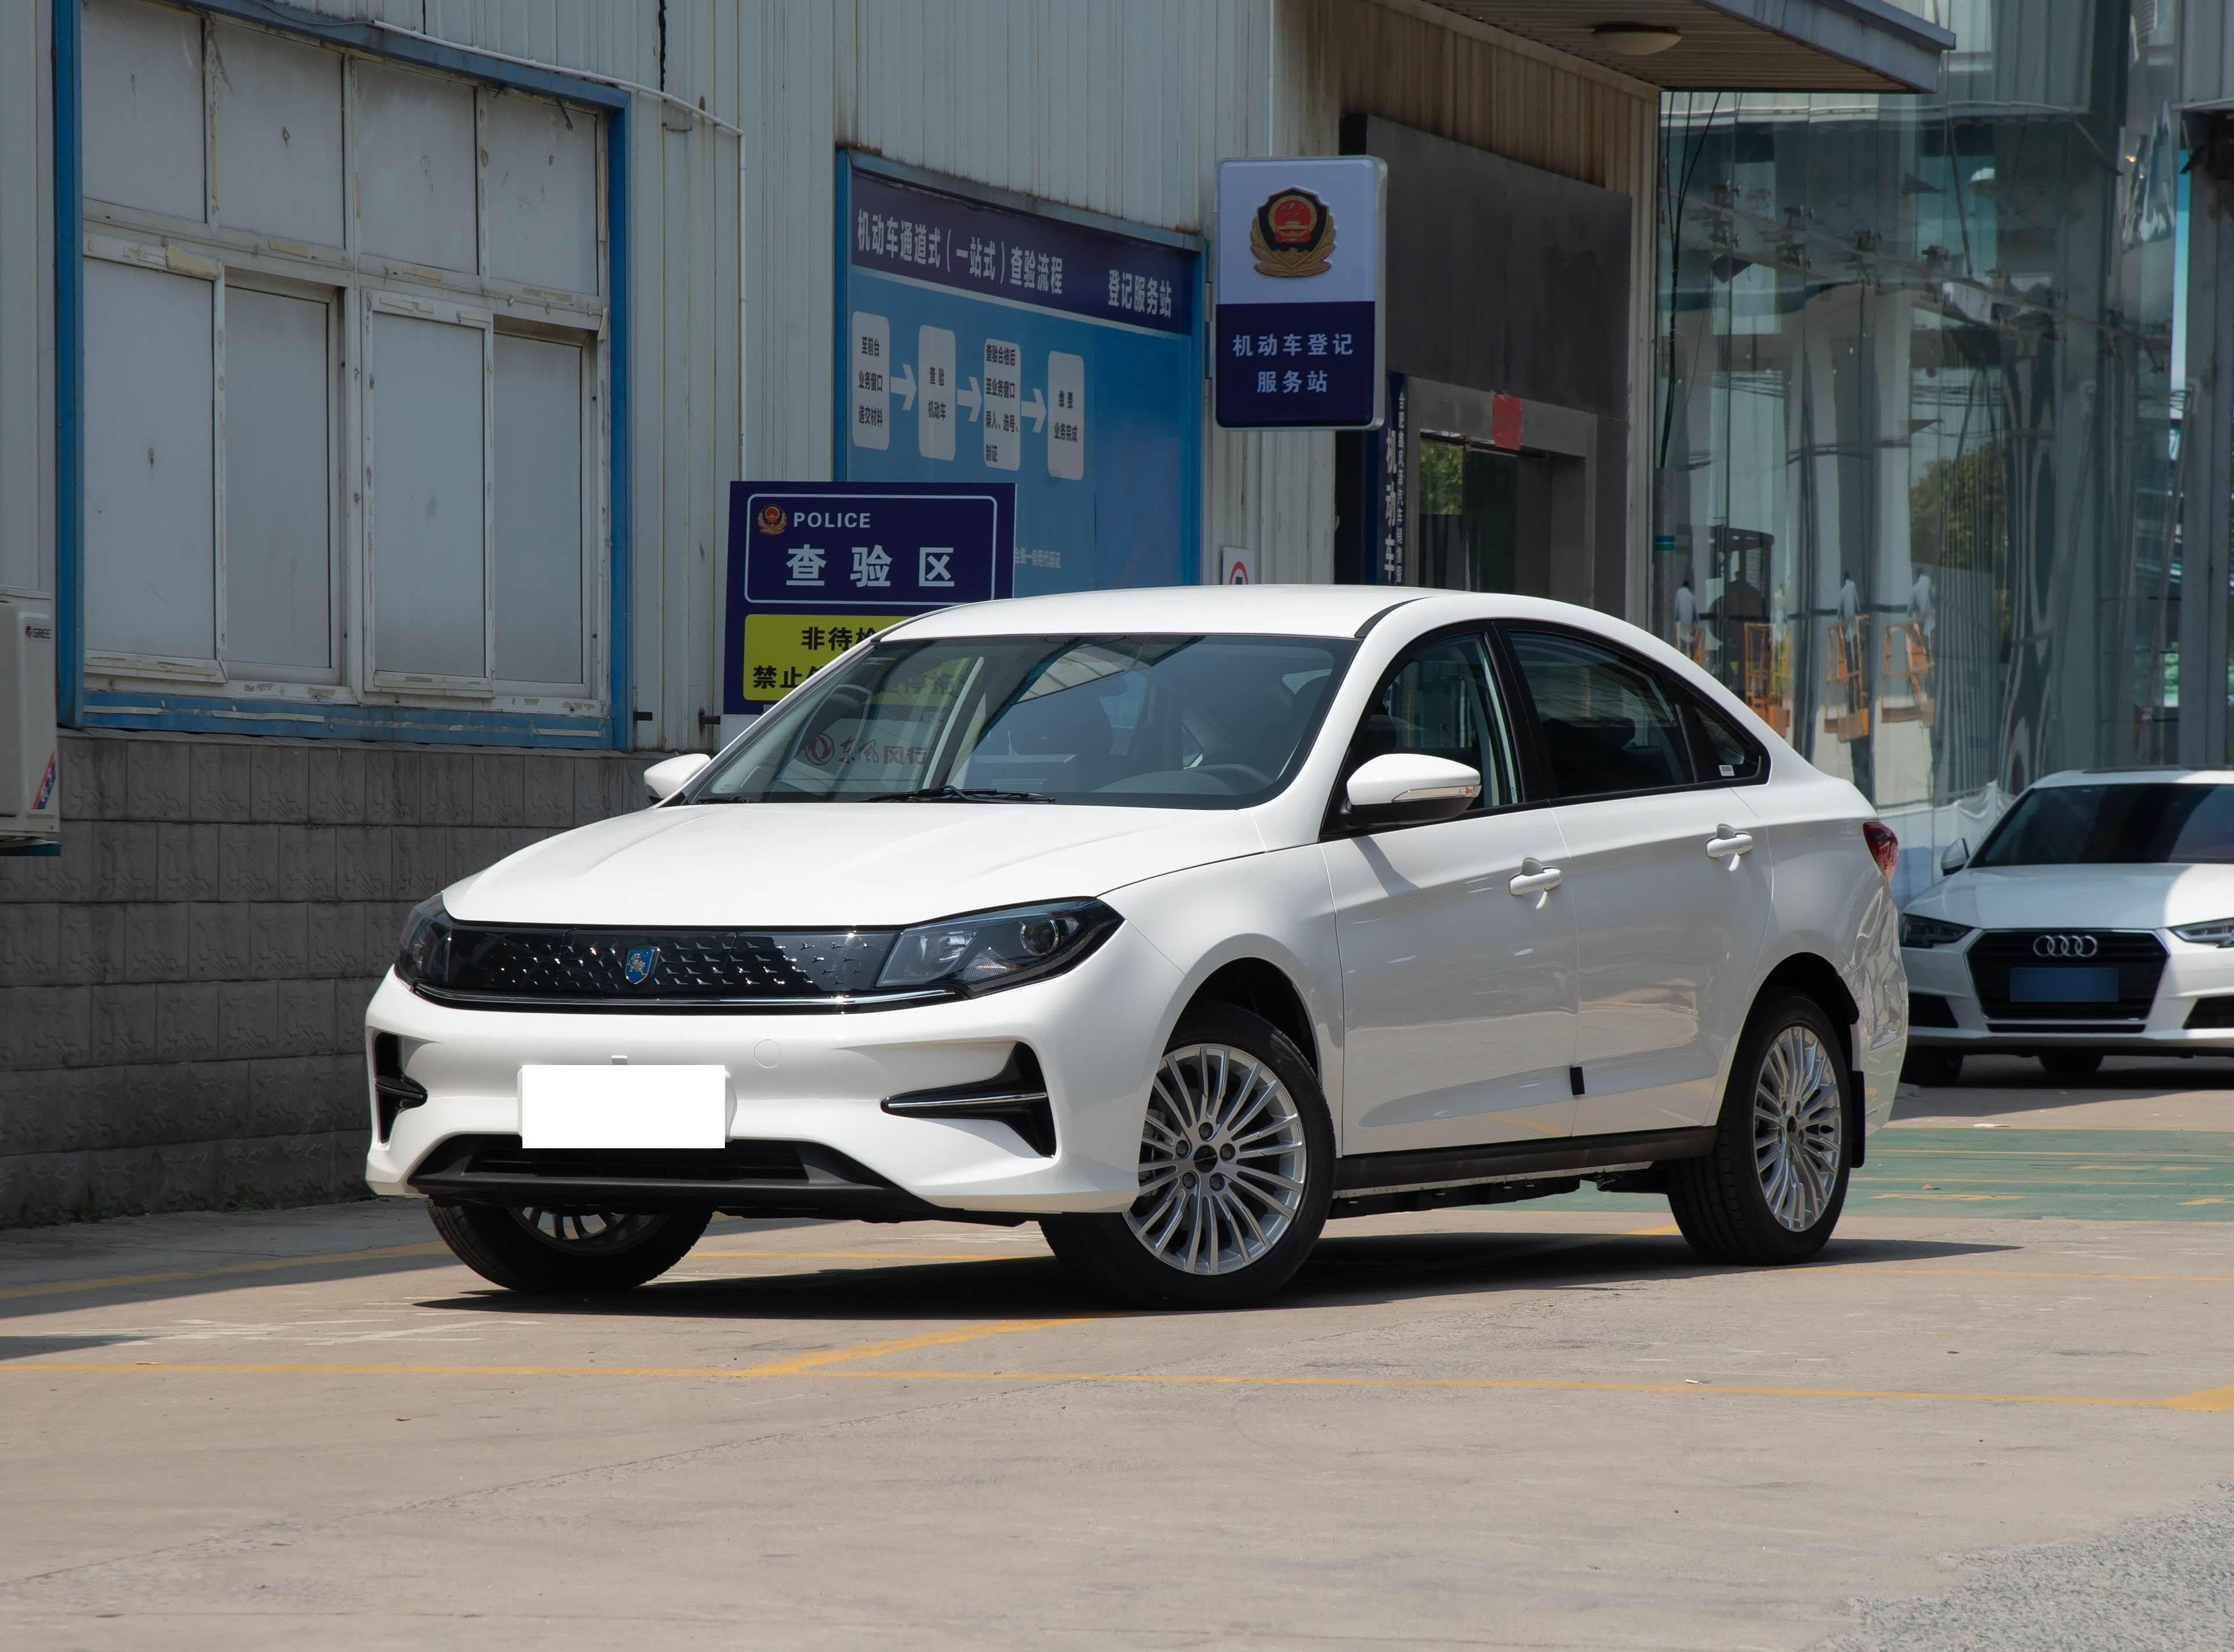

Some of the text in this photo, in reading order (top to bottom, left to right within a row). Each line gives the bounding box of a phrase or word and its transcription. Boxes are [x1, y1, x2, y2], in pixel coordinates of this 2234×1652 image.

[1107, 269, 1172, 318] 登记服务站
[1232, 333, 1354, 357] 机动车登记
[858, 370, 883, 392] 业务窗口
[986, 377, 1015, 400] 至业务窗口
[1257, 370, 1328, 393] 服务站
[794, 511, 871, 528] POLICE
[785, 544, 955, 588] 查验区
[33, 628, 52, 639] GREE
